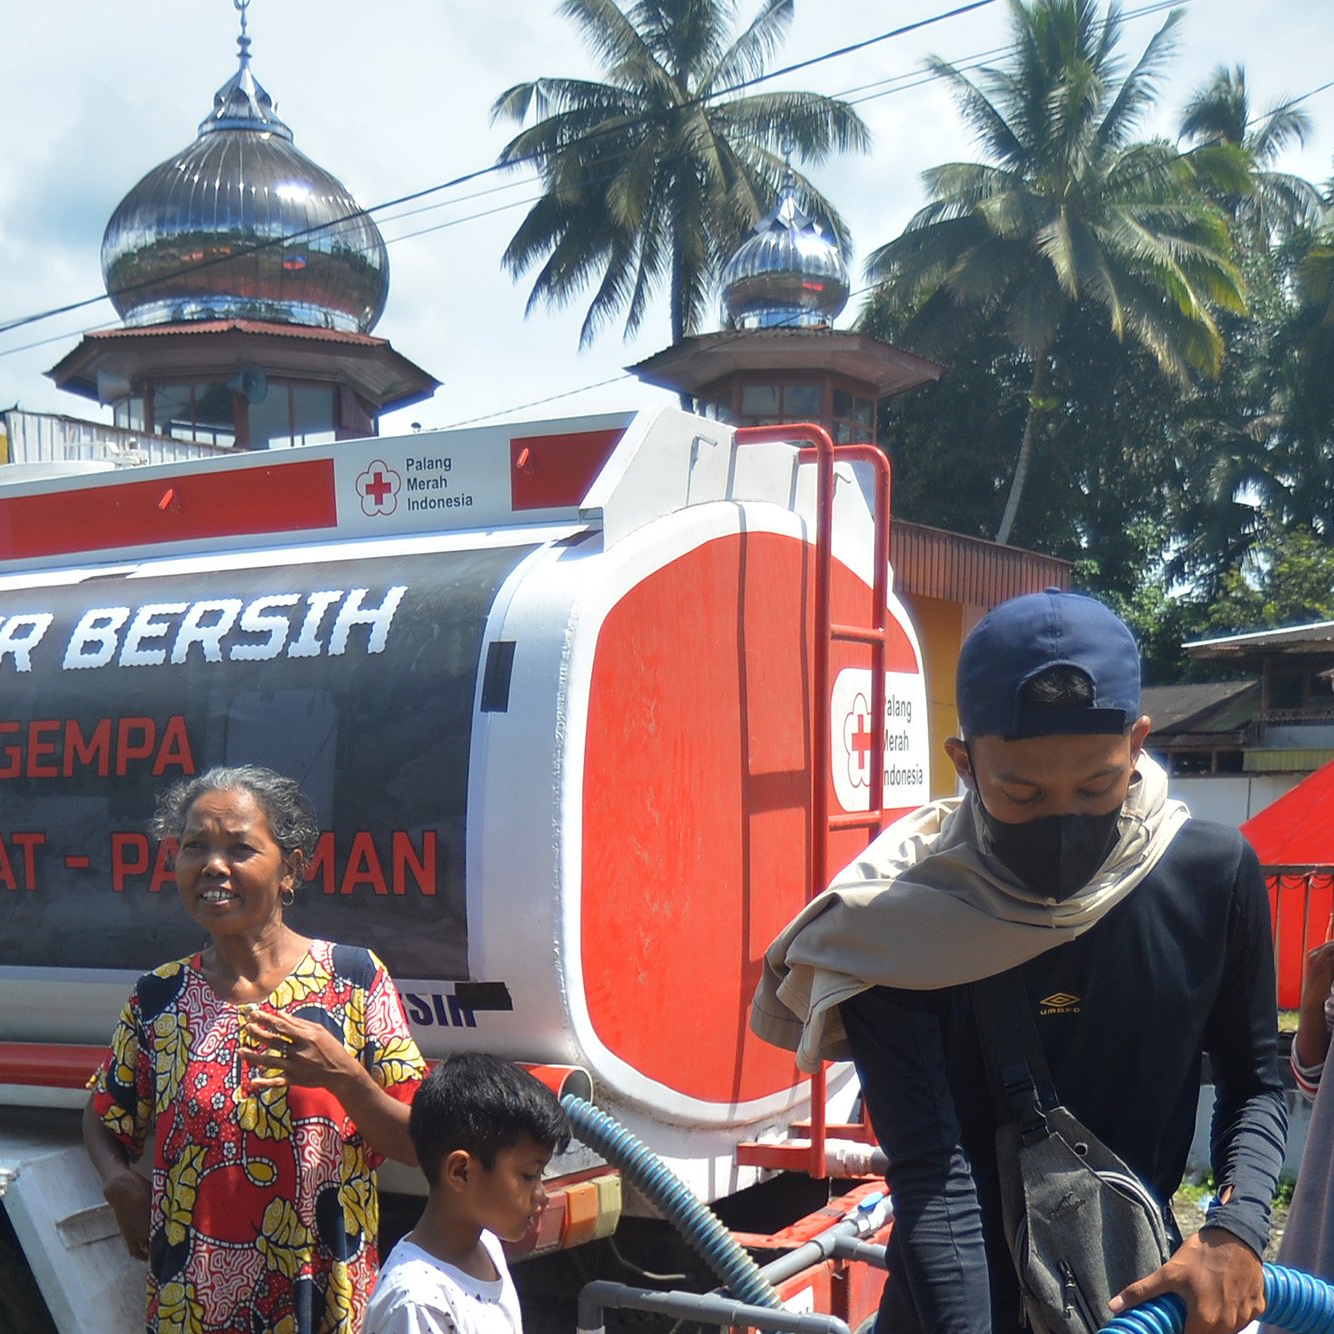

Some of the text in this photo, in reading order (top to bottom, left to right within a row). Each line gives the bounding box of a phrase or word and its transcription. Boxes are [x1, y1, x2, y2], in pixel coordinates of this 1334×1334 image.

[406, 457, 452, 472] Palang
[407, 475, 447, 491] Merah
[407, 493, 473, 511] Indonesia
[63, 585, 408, 671] BERSIH
[886, 694, 911, 723] alang
[883, 763, 923, 786] ndonesia
[110, 830, 437, 896] PAMAN
